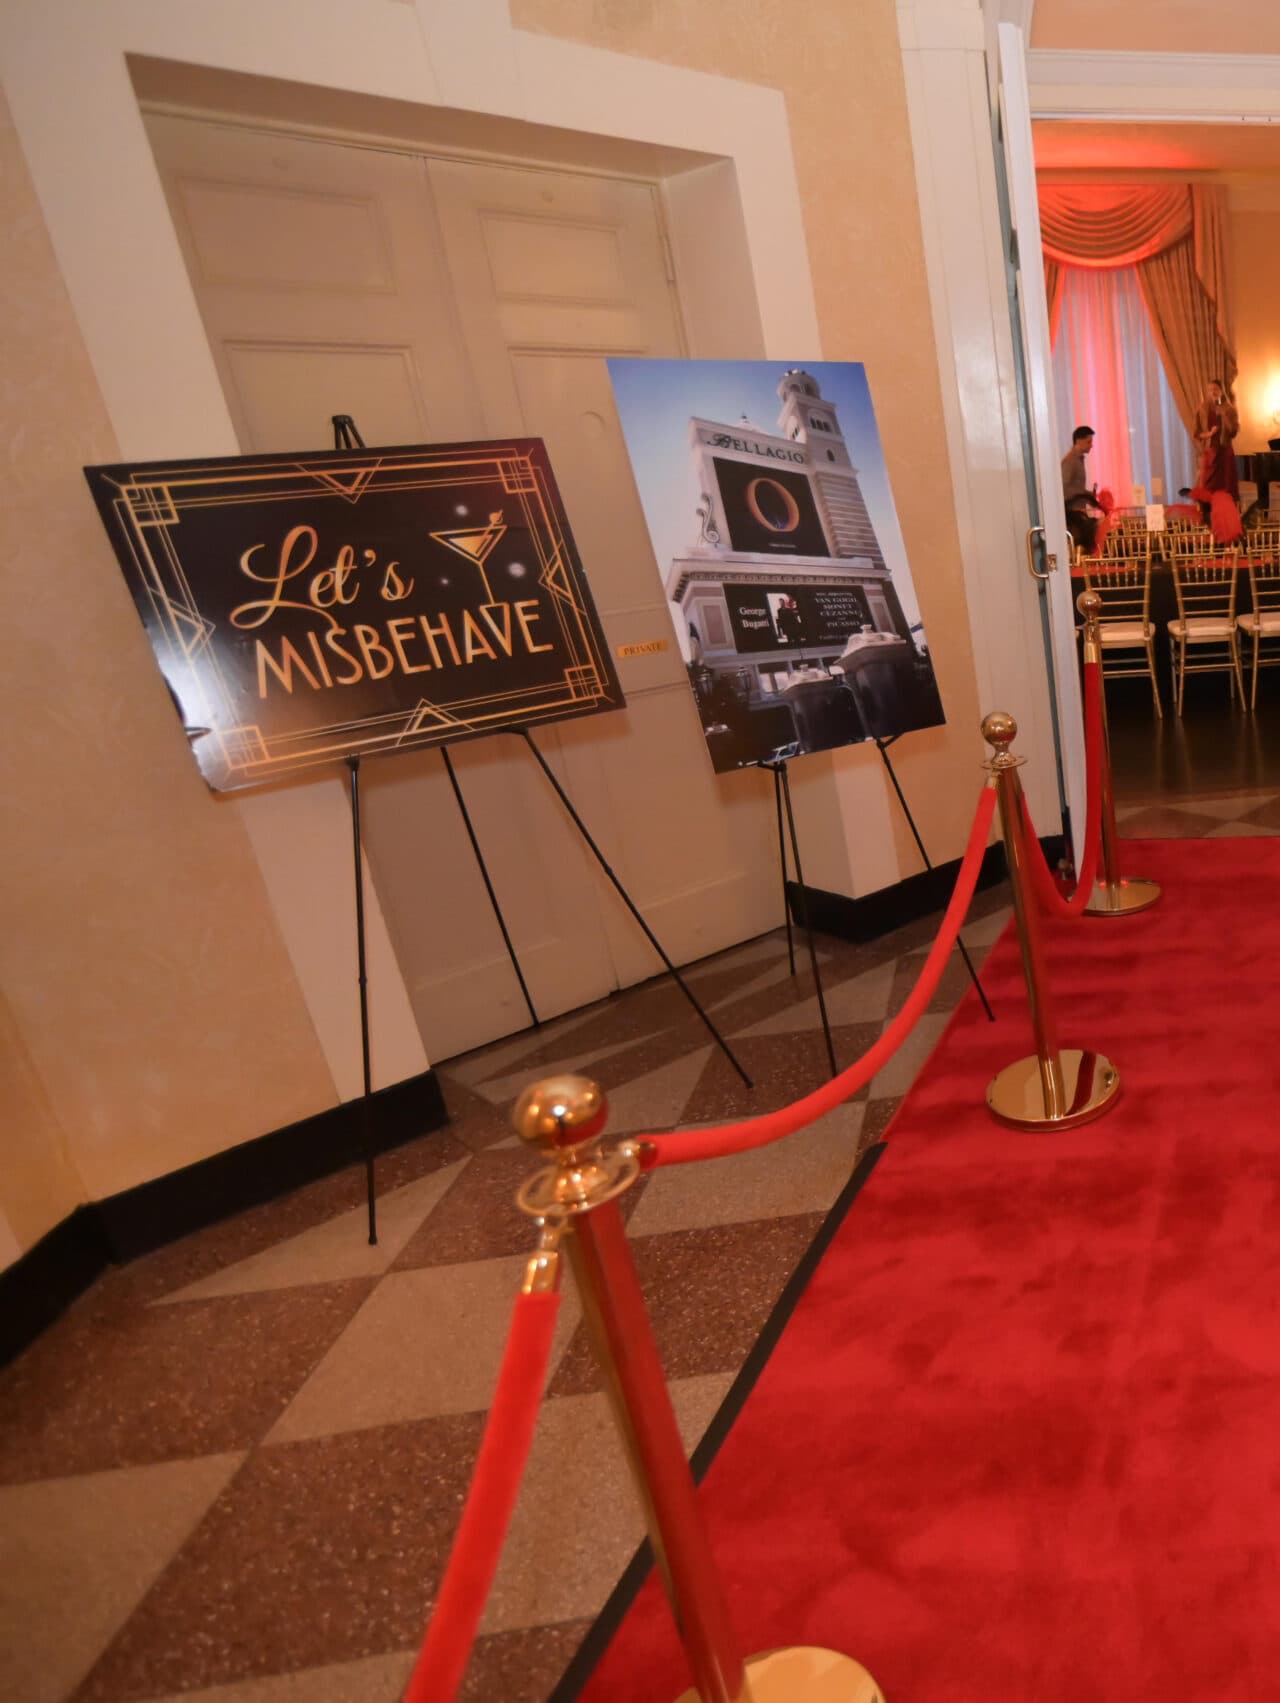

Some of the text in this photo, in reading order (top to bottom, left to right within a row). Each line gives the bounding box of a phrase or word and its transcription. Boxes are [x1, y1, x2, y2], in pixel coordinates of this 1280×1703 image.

[707, 433, 804, 464] BELLAGIO
[740, 607, 766, 616] George
[253, 599, 554, 699] MISBEHAVE
[624, 642, 661, 655] PRIVATE
